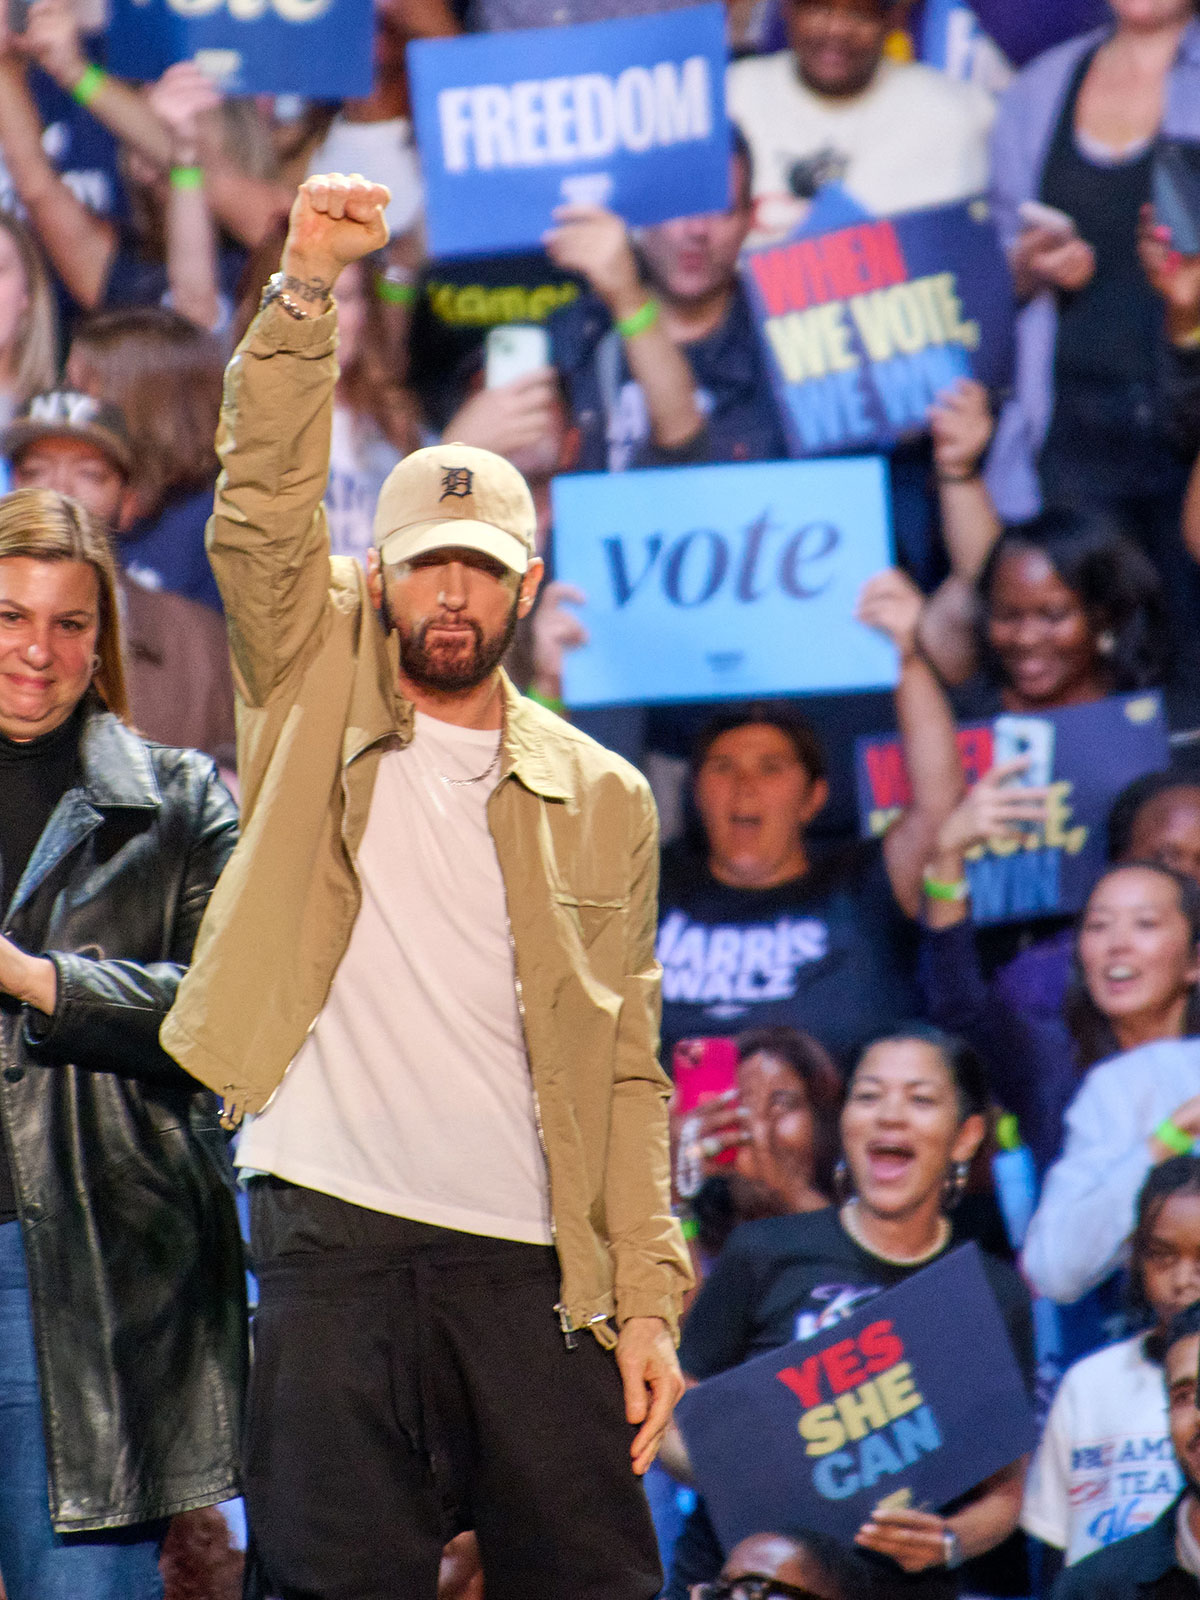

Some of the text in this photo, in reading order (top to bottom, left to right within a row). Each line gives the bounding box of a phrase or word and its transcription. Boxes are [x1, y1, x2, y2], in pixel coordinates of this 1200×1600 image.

[438, 56, 710, 174] FREEDOM
[750, 220, 907, 318] WHEN
[764, 302, 858, 384] WE
[604, 506, 842, 610] vote
[776, 1319, 903, 1408] YES
[798, 1362, 924, 1458] SHE
[813, 1405, 942, 1500] CAN
